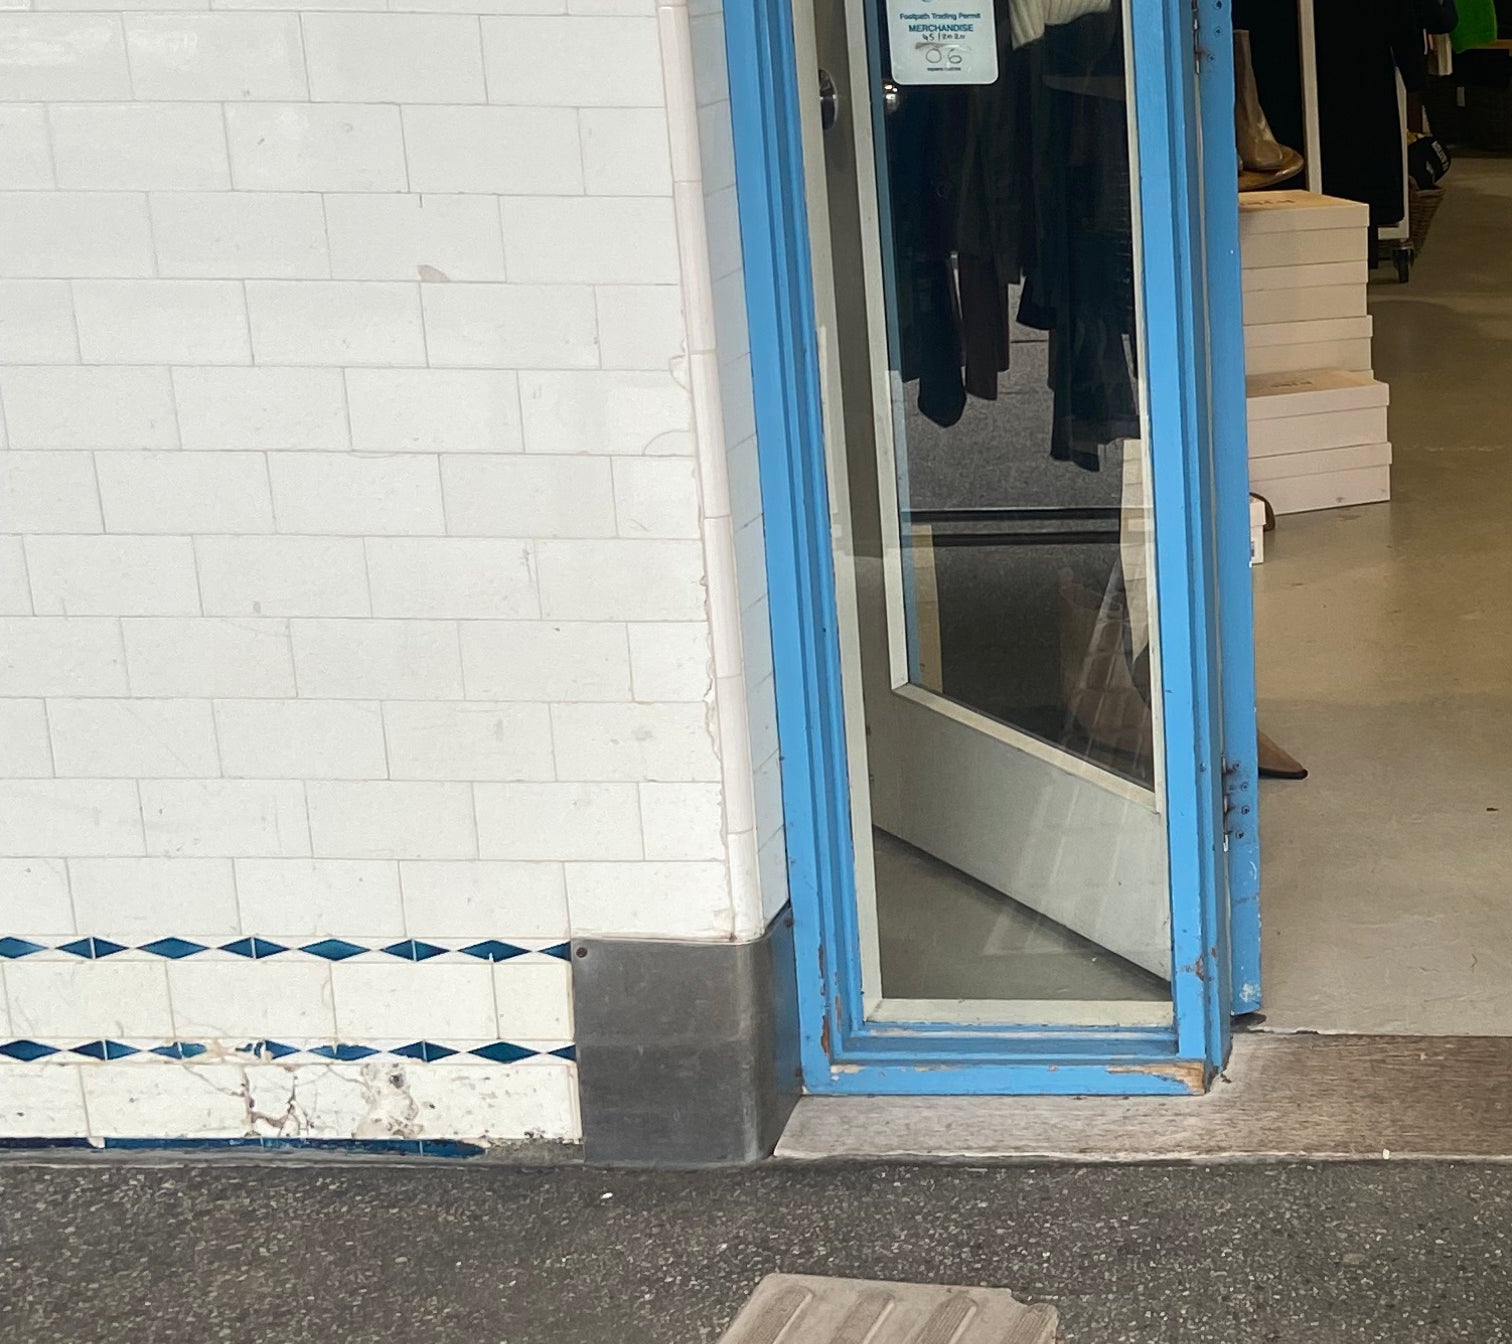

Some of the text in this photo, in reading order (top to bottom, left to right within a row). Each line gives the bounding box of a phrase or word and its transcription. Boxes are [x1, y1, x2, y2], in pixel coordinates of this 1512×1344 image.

[931, 12, 957, 21] Trading
[958, 12, 981, 20] Permit
[908, 23, 974, 32] MERCHANDISE
